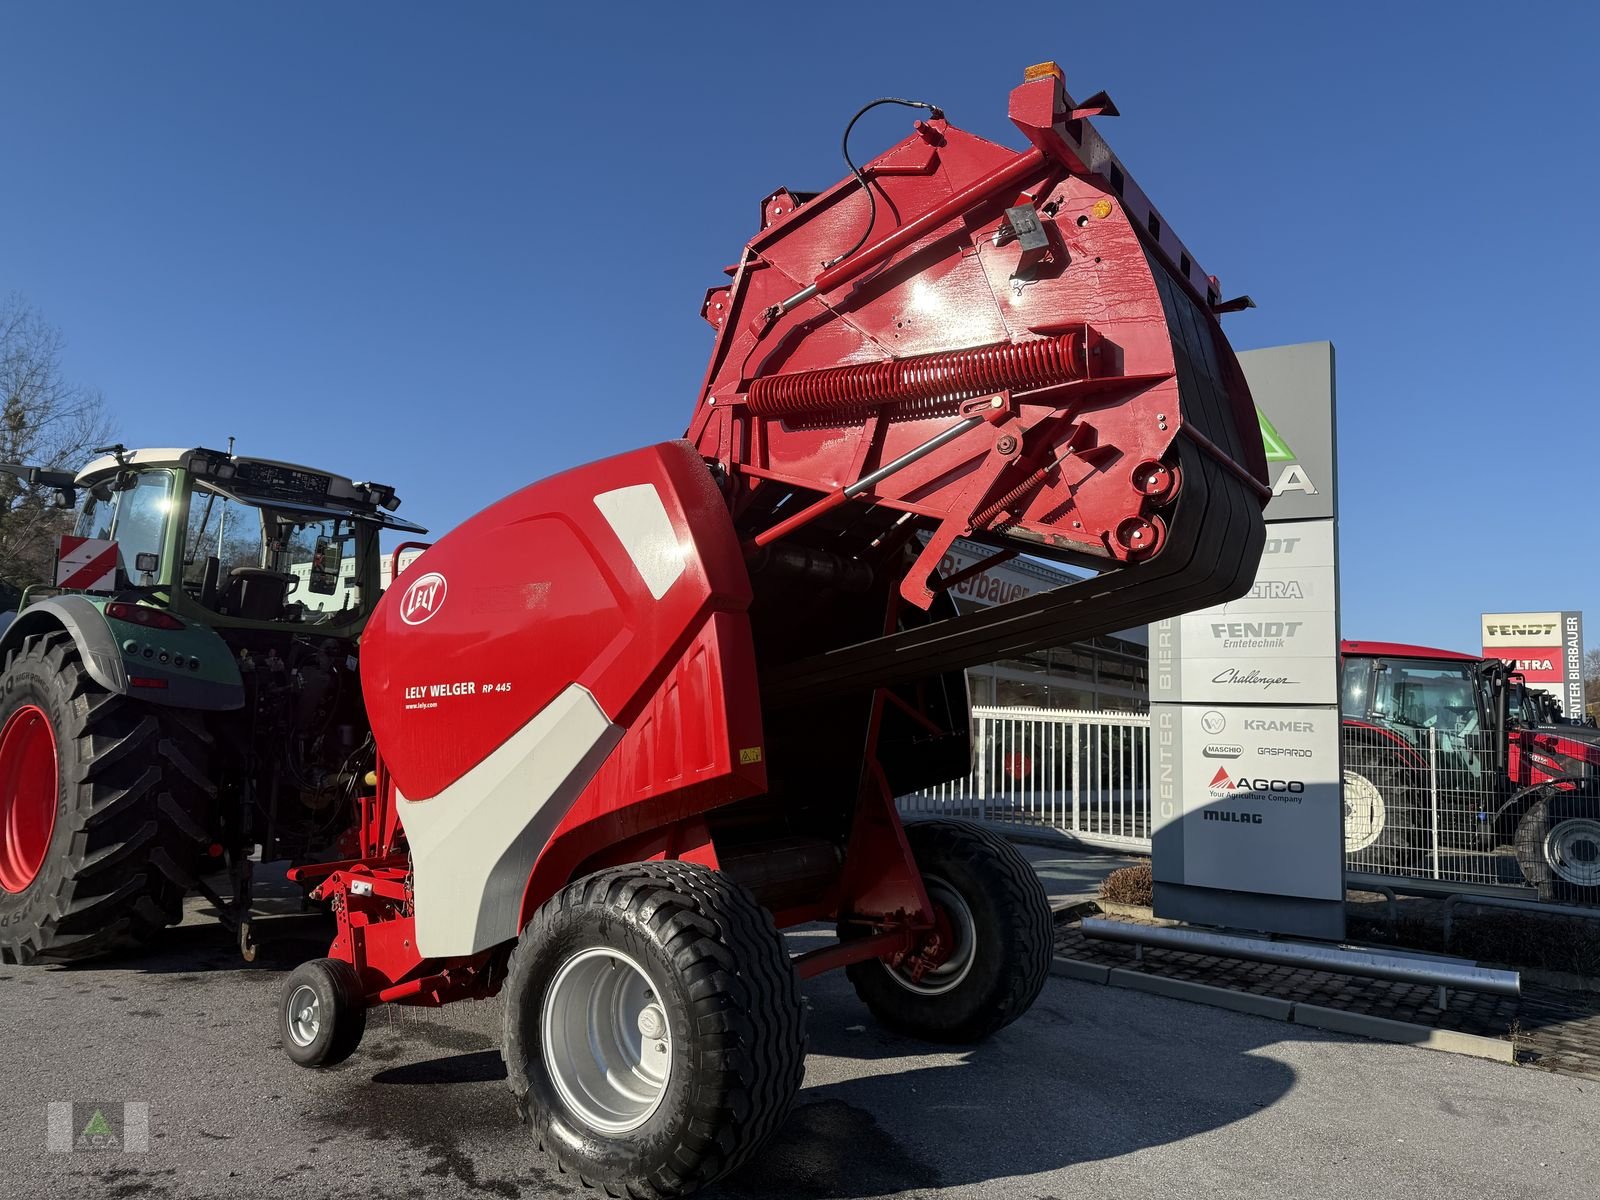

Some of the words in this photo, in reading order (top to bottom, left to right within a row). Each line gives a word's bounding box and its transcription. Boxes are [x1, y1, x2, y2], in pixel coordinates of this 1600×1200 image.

[406, 579, 442, 617] LELY
[1211, 622, 1303, 638] FENDT
[1487, 624, 1556, 635] FENDT
[1223, 639, 1284, 648] Erntetechnik
[1566, 617, 1579, 679] BIERBAUER
[1212, 668, 1302, 689] Challenger
[405, 686, 427, 699] LELY
[430, 682, 475, 697] WELGER
[482, 684, 493, 693] RP
[495, 683, 511, 692] 445
[1244, 720, 1314, 732] KRAMER
[1257, 747, 1312, 757] GASPARDO
[1159, 712, 1173, 819] CENTER
[1237, 778, 1304, 793] AGCO
[1209, 790, 1224, 798] Your
[1226, 791, 1265, 801] Agriculture
[1268, 793, 1302, 804] Company
[1203, 810, 1262, 824] MULAG
